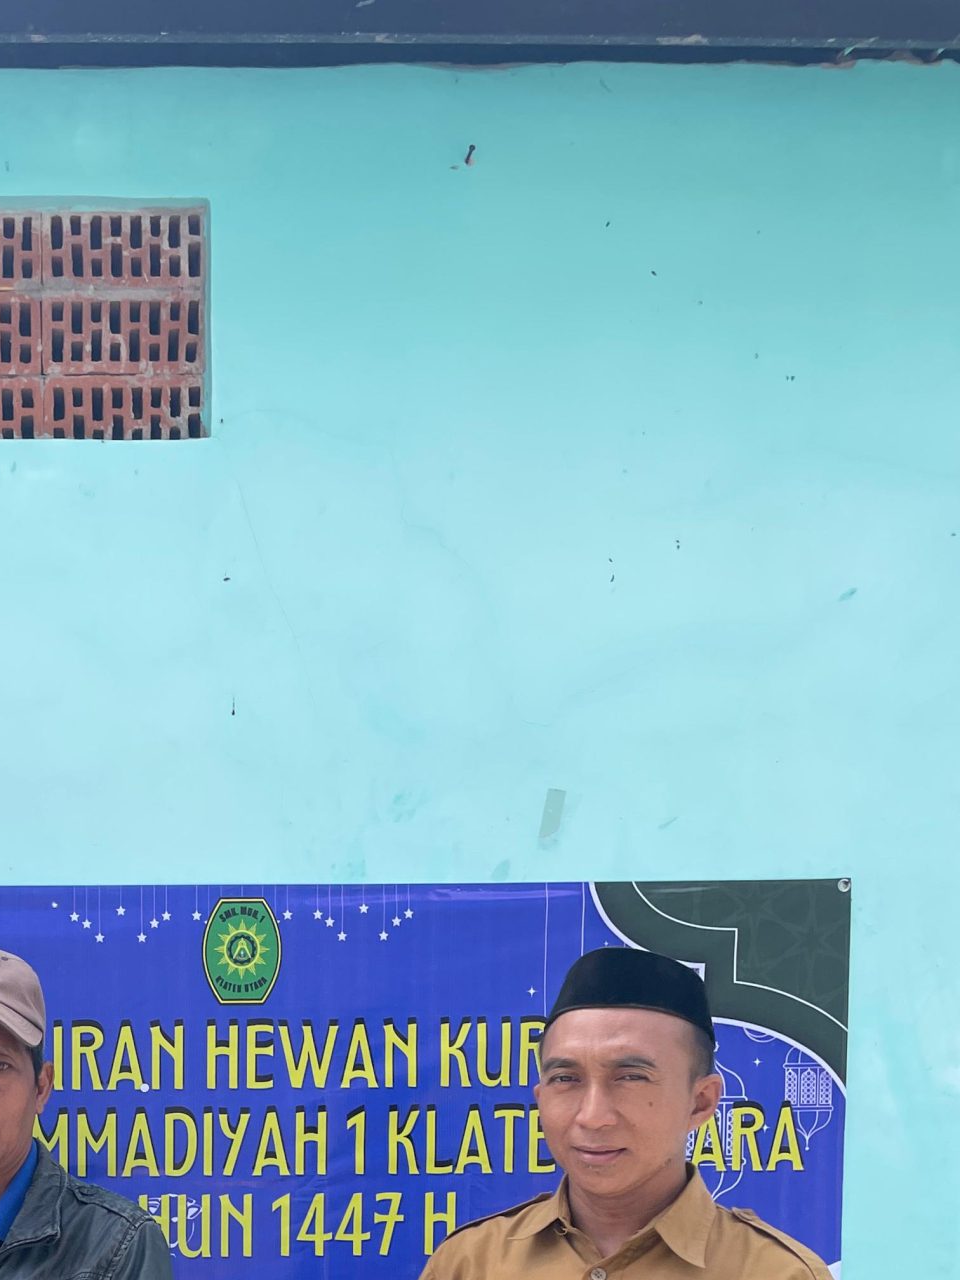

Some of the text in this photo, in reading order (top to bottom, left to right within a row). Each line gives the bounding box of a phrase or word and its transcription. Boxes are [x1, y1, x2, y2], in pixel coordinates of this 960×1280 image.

[206, 1022, 418, 1090] HEWAN
[439, 1020, 546, 1088] KUR
[346, 1110, 366, 1175] 1
[387, 1108, 558, 1175] KLATE
[690, 1105, 805, 1172] ARA
[271, 1191, 405, 1257] 1447
[423, 1190, 457, 1256] H
